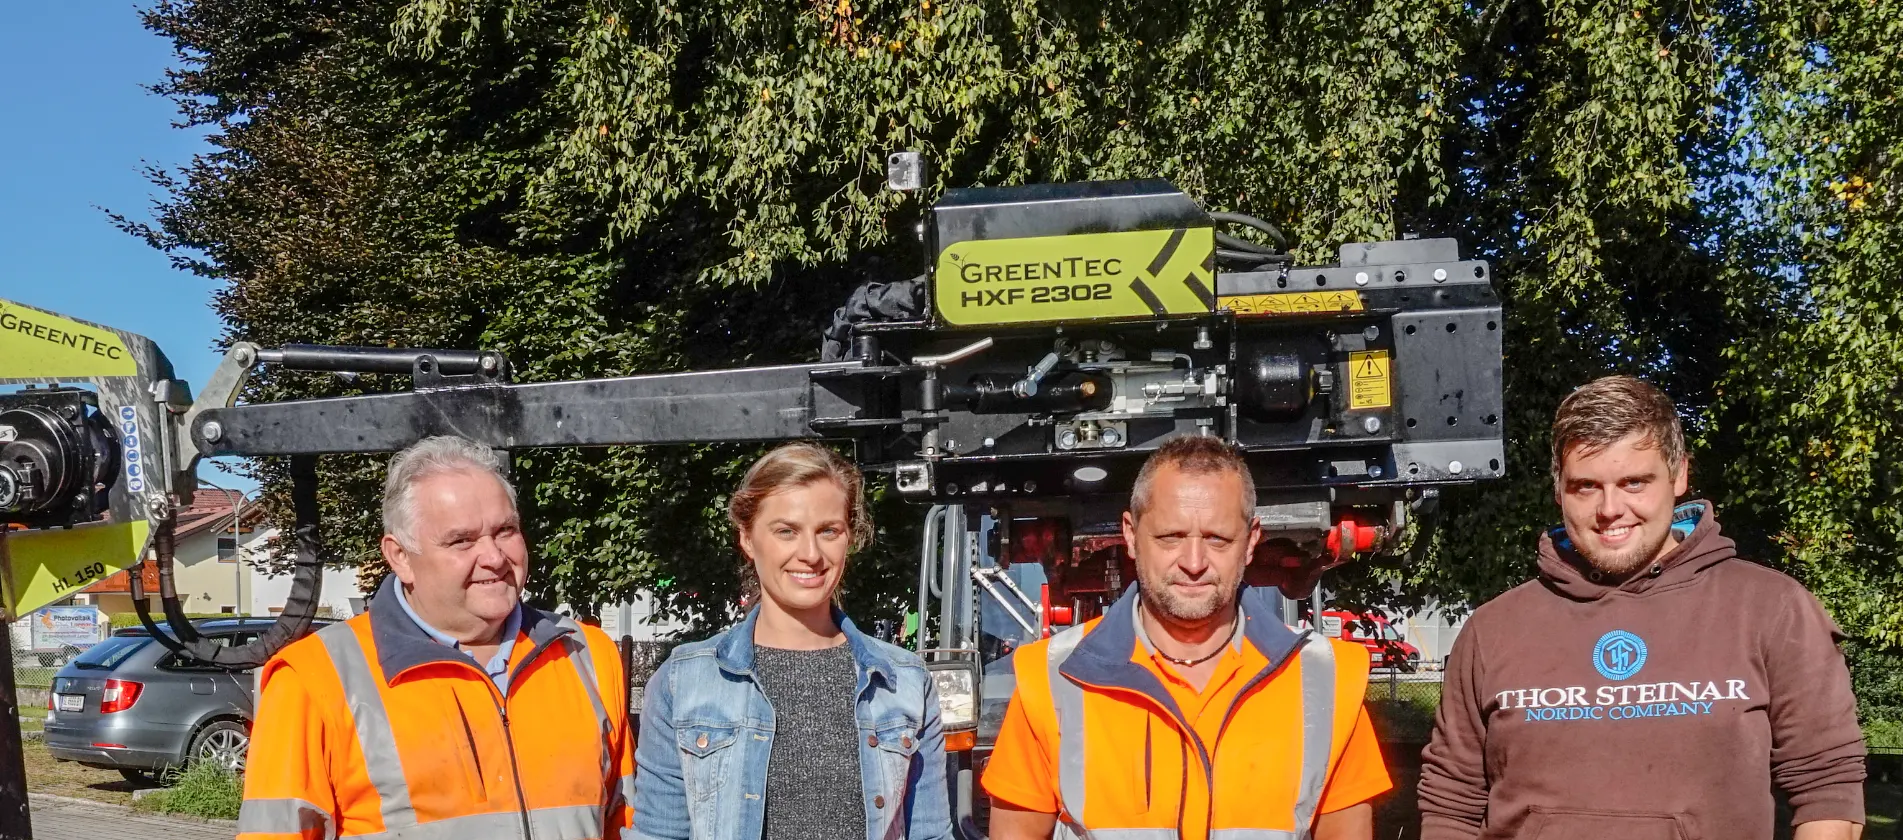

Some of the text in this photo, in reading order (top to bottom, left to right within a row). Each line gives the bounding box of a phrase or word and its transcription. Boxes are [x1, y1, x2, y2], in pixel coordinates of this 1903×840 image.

[961, 283, 1113, 308] HXF 2302
[52, 562, 105, 594] HL 150
[53, 614, 91, 622] Photovoltaik
[1495, 679, 1750, 710] THOR STEINAR
[1525, 701, 1713, 722] NORDIC COMPANY
